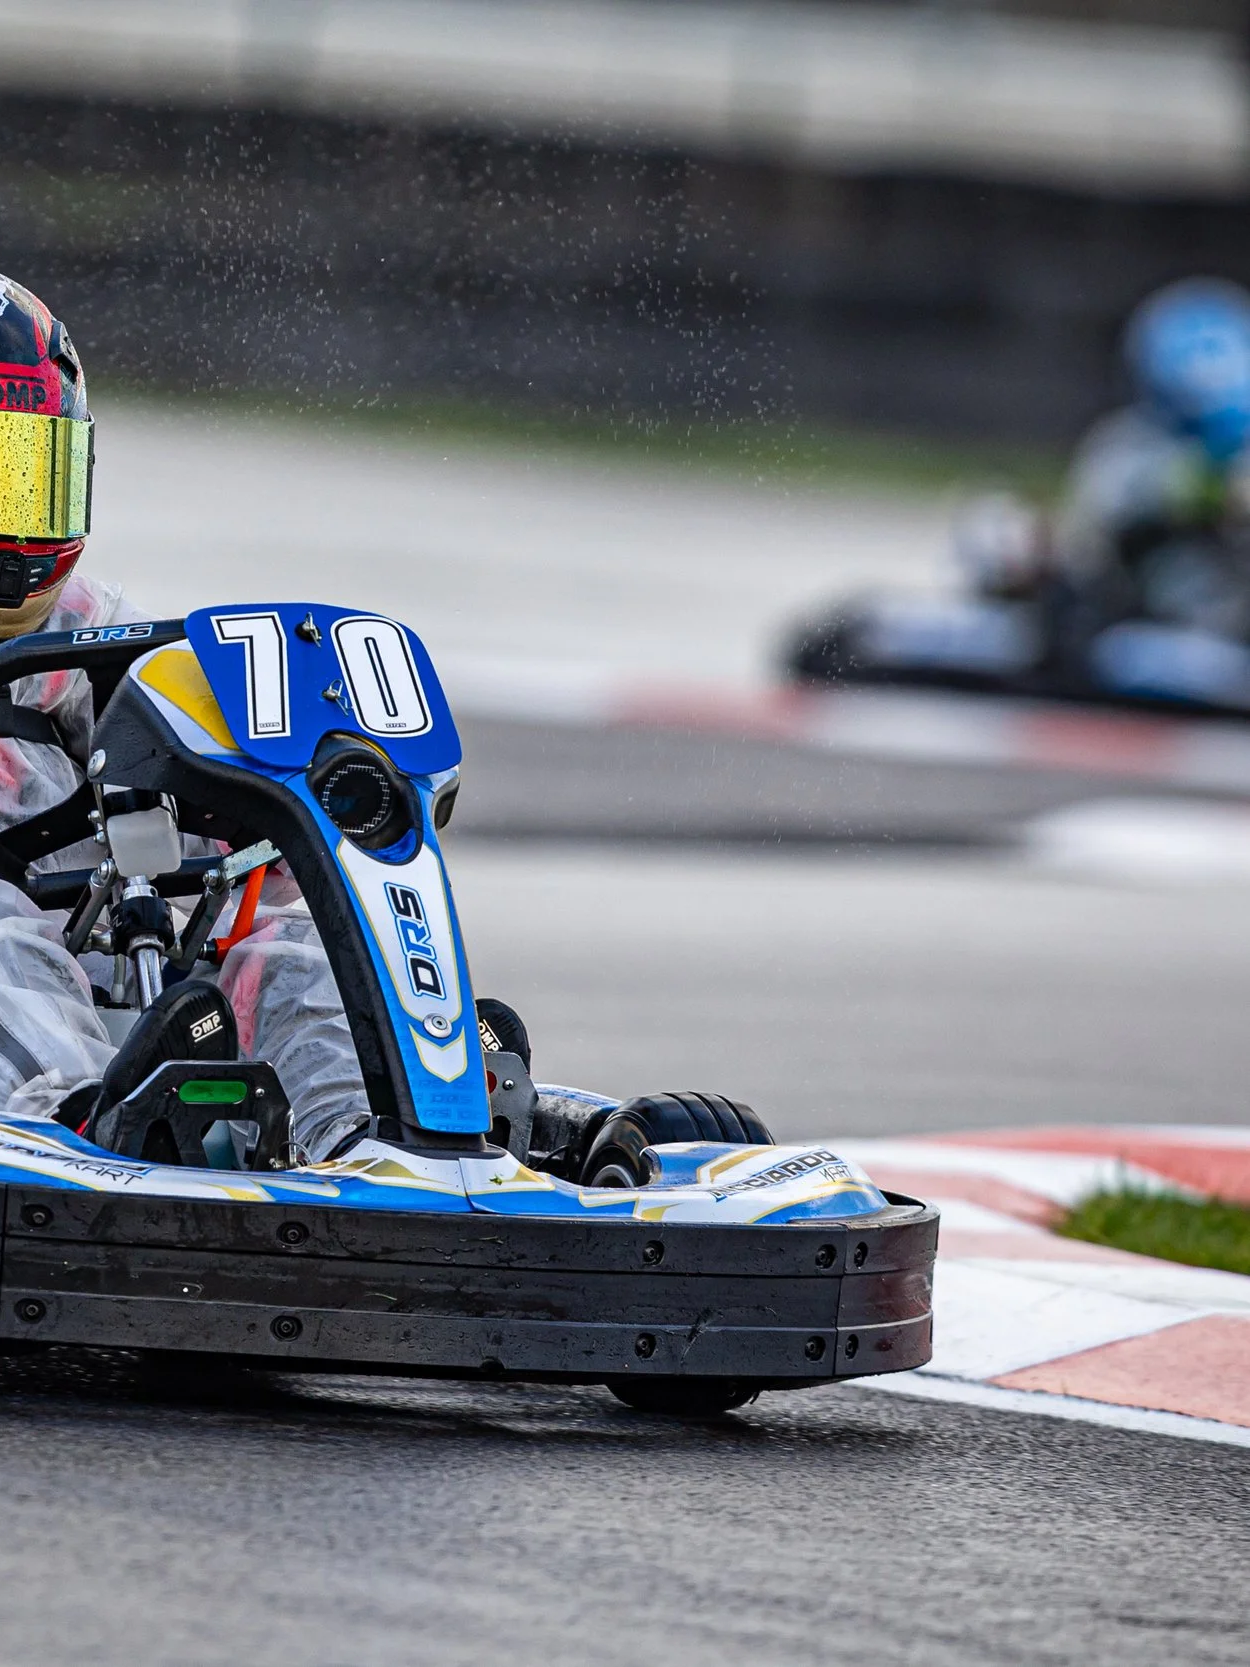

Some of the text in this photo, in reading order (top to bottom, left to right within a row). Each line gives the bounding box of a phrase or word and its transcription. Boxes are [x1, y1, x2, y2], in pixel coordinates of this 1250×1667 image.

[72, 624, 153, 644] DRS
[210, 611, 434, 739] 70
[384, 882, 447, 1000] DRS
[191, 1014, 221, 1038] OMP
[478, 1022, 499, 1051] OMP
[62, 1160, 143, 1185] KART
[818, 1165, 853, 1182] KART
